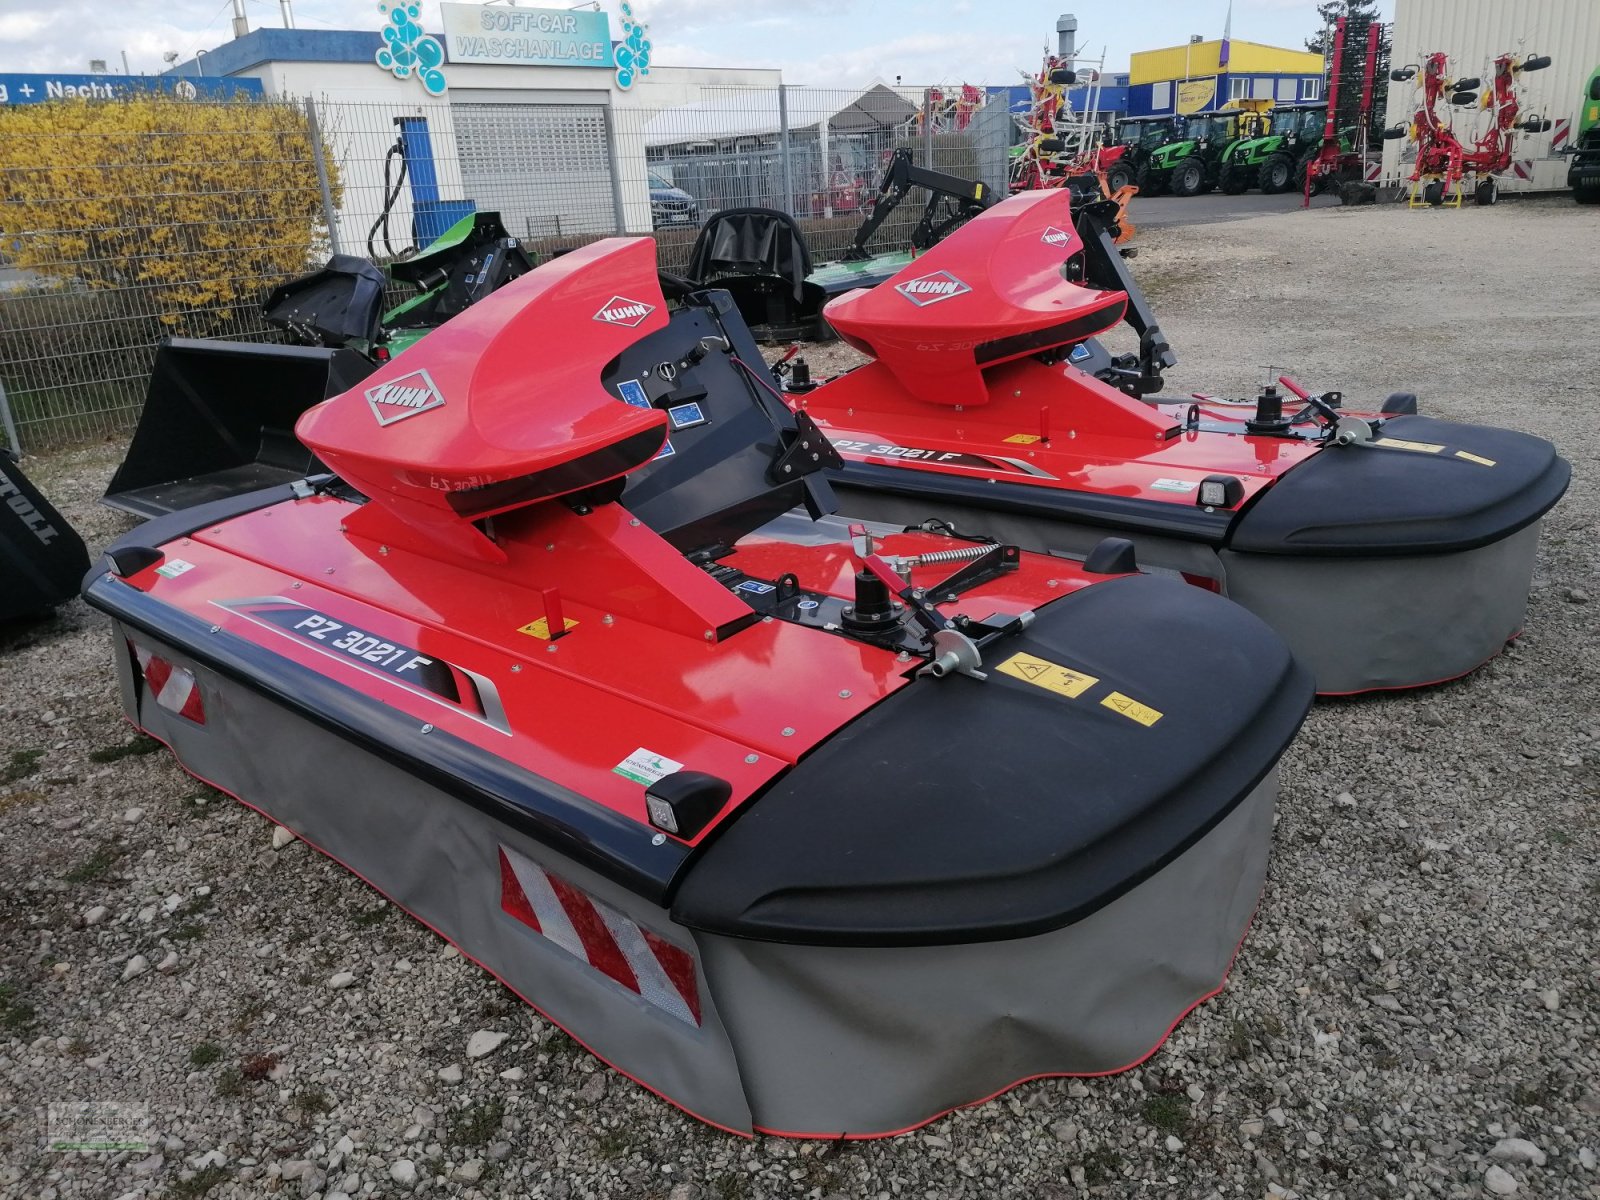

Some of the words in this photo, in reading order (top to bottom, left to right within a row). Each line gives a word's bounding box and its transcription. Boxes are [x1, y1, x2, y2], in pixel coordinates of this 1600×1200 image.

[481, 11, 578, 33] SOFT-CAR
[456, 36, 605, 60] WASCHANLAGE
[45, 80, 113, 99] Nacht
[1044, 232, 1068, 243] KUHN
[904, 280, 960, 294] KUHN
[602, 304, 647, 321] KUHN
[372, 384, 434, 408] KUHN
[832, 439, 869, 451] PZ
[871, 445, 936, 459] 3021
[937, 452, 962, 461] F
[293, 614, 343, 640] PZ
[332, 630, 407, 666] 3021
[395, 655, 433, 673] F
